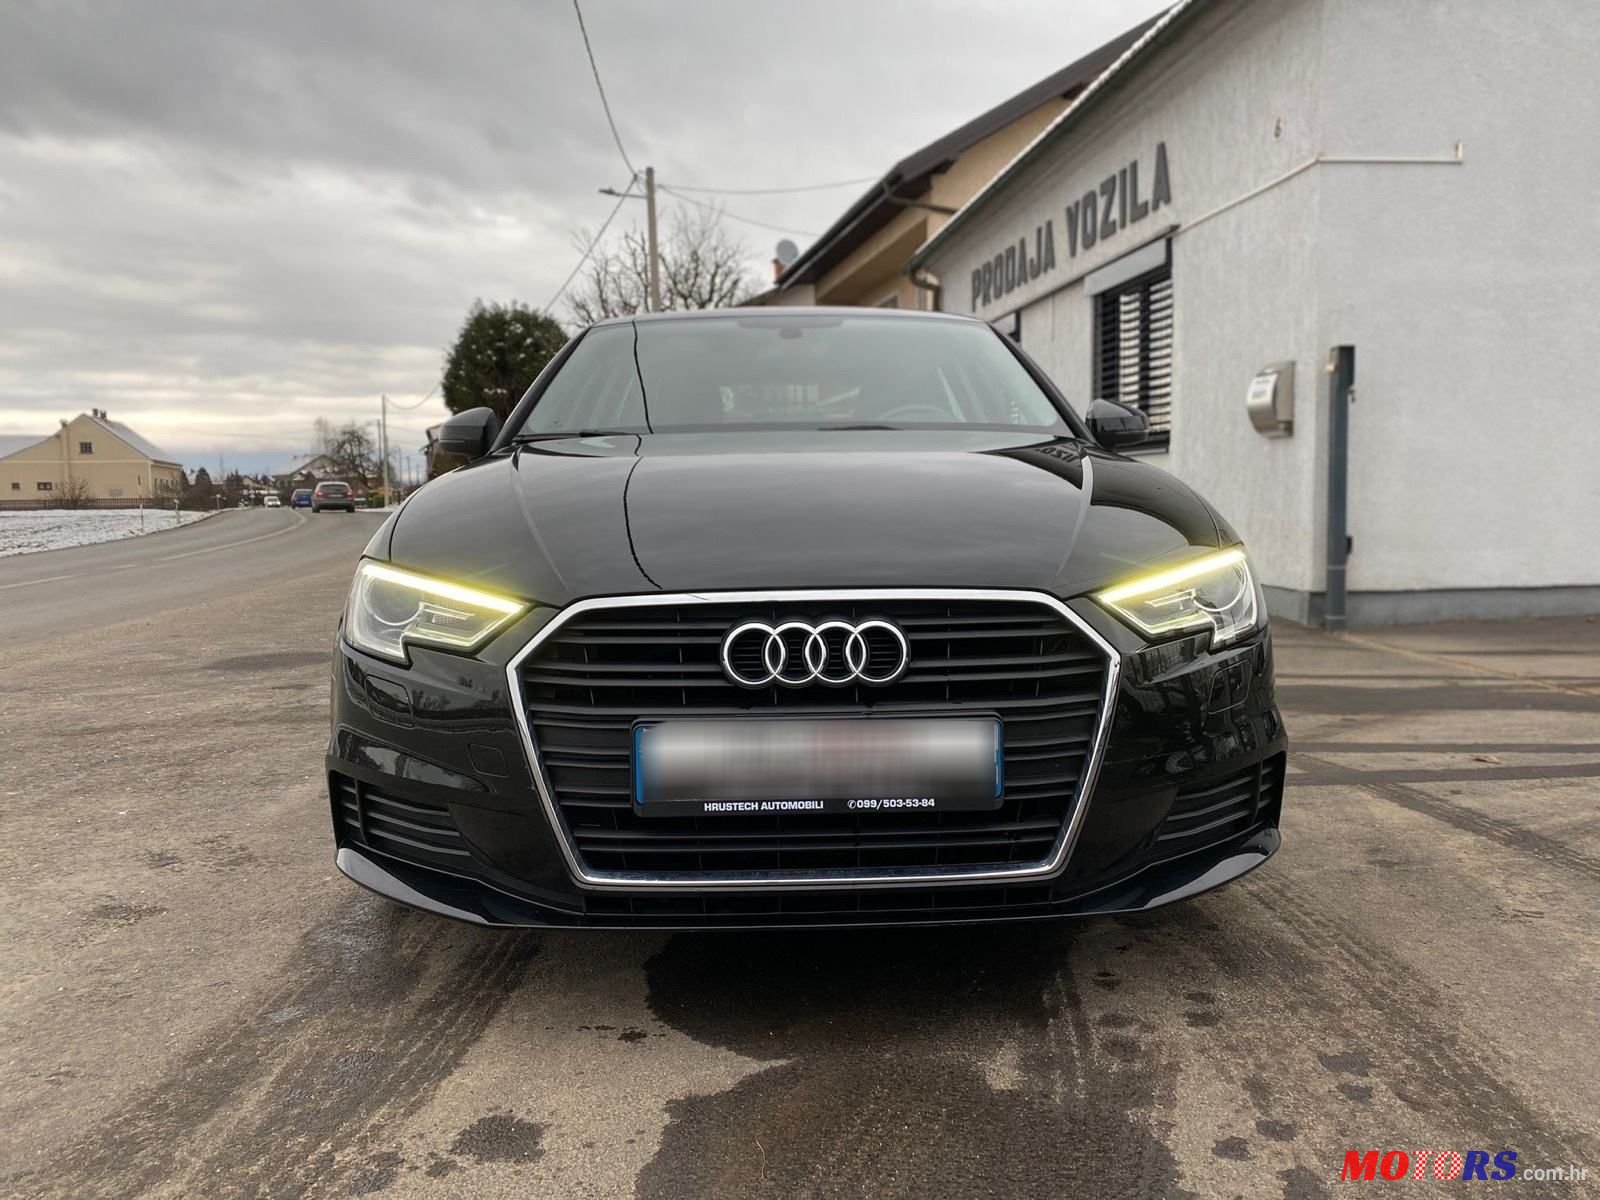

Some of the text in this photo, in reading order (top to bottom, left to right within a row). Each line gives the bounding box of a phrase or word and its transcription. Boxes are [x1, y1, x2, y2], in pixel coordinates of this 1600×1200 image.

[971, 141, 1172, 313] PRODAJA VOZILA
[704, 798, 936, 811] HRUSTECH AUTOMOBILI 099/503-53-84
